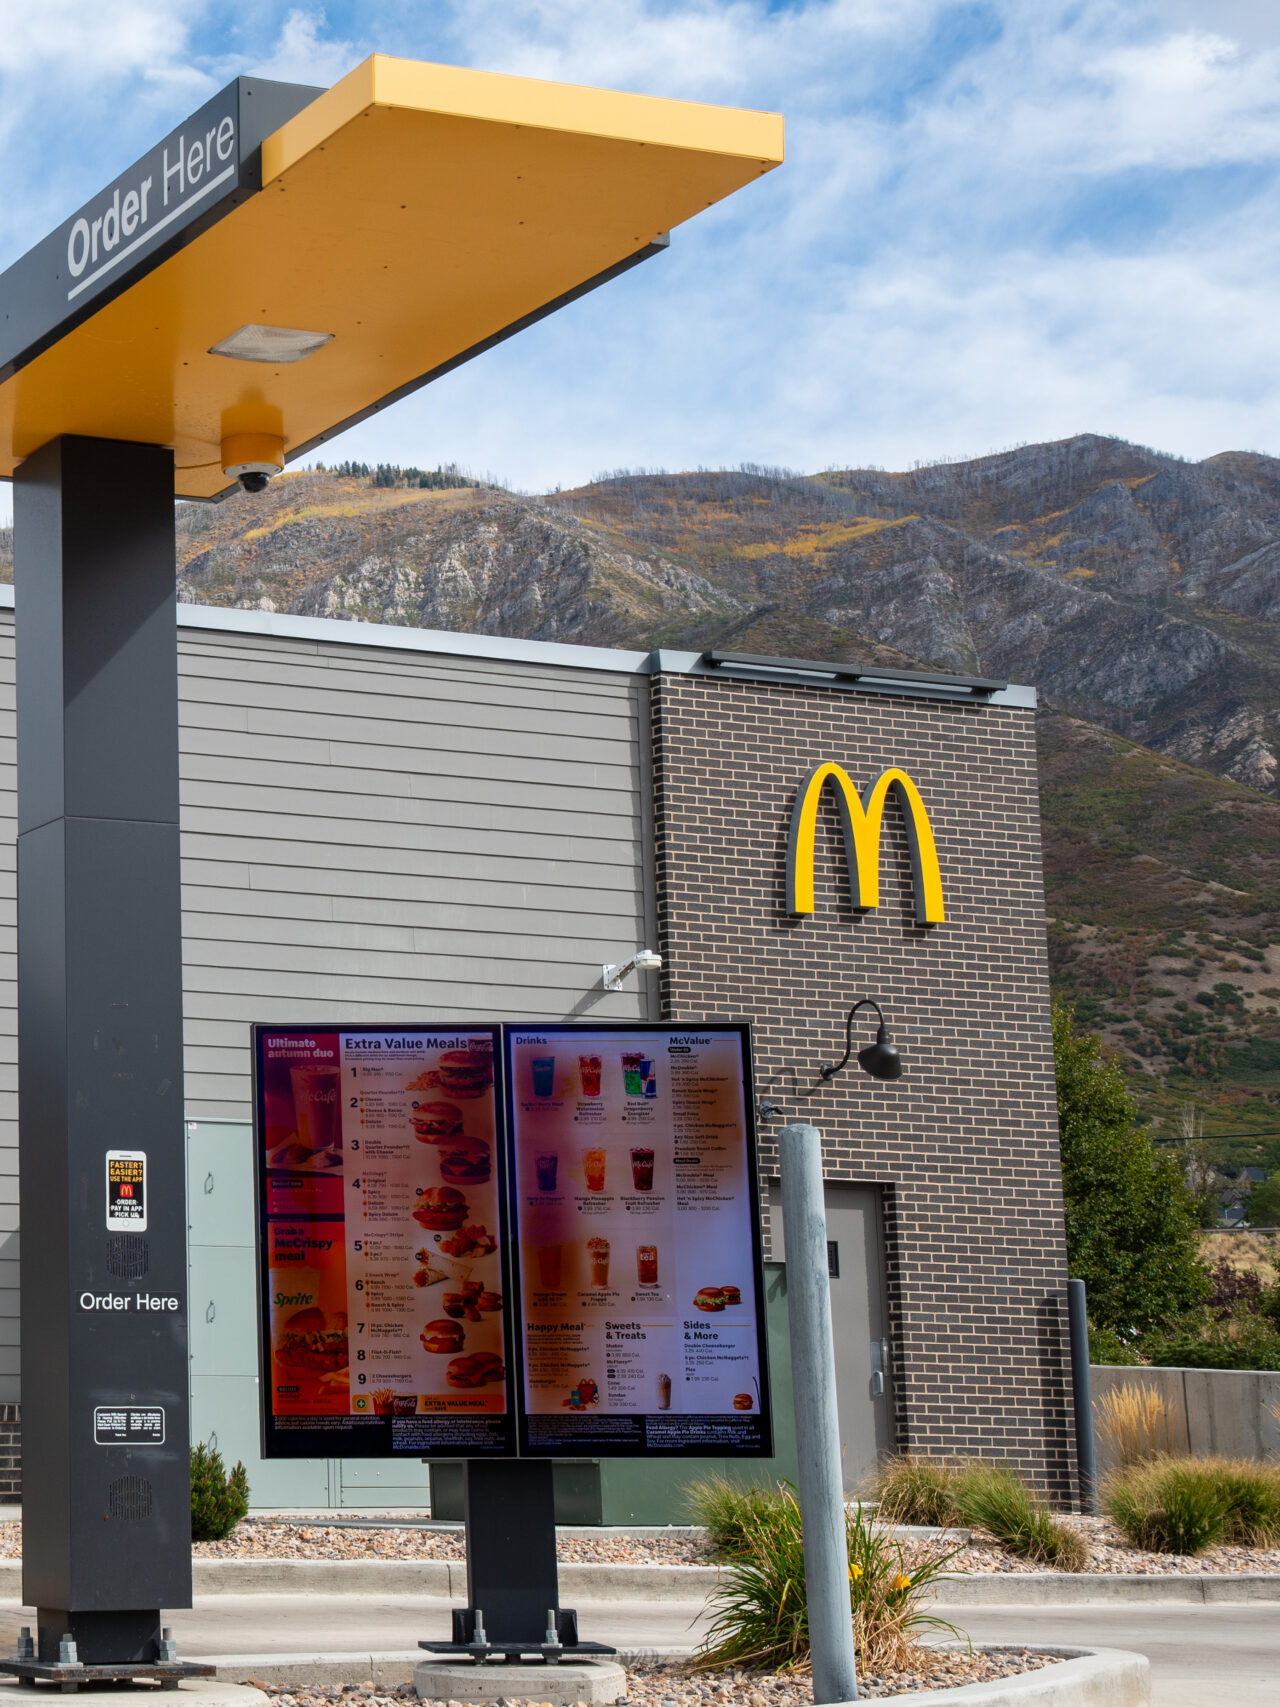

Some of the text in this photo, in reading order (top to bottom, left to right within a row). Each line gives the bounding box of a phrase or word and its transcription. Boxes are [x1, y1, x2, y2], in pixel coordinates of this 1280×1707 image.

[67, 116, 234, 277] Order Here
[268, 1037, 316, 1048] Ultimate
[345, 1038, 381, 1049] Extra
[384, 1038, 423, 1049] Value
[426, 1037, 468, 1049] Meals
[516, 1036, 548, 1045] Drinks
[669, 1037, 711, 1045] McValue
[268, 1049, 310, 1058] autumn
[312, 1048, 334, 1058] duo
[351, 1067, 357, 1078] 1
[350, 1098, 358, 1108] 2
[352, 1140, 359, 1150] 3
[110, 1161, 143, 1169] FASTER?
[110, 1168, 143, 1176] EASIER?
[352, 1178, 360, 1189] 4
[274, 1227, 294, 1235] Grab
[274, 1237, 333, 1251] McCrispy
[354, 1240, 363, 1251] 5
[274, 1251, 305, 1261] meal
[355, 1280, 364, 1291] 6
[79, 1292, 179, 1311] Order Here
[274, 1292, 313, 1308] Sprite
[357, 1323, 365, 1334] 7
[527, 1323, 584, 1333] Happy Meal
[605, 1321, 641, 1330] Sweets
[683, 1321, 711, 1330] Sides
[605, 1331, 646, 1340] & Treats
[684, 1332, 719, 1340] & More
[357, 1350, 366, 1361] 8
[358, 1373, 366, 1384] 9
